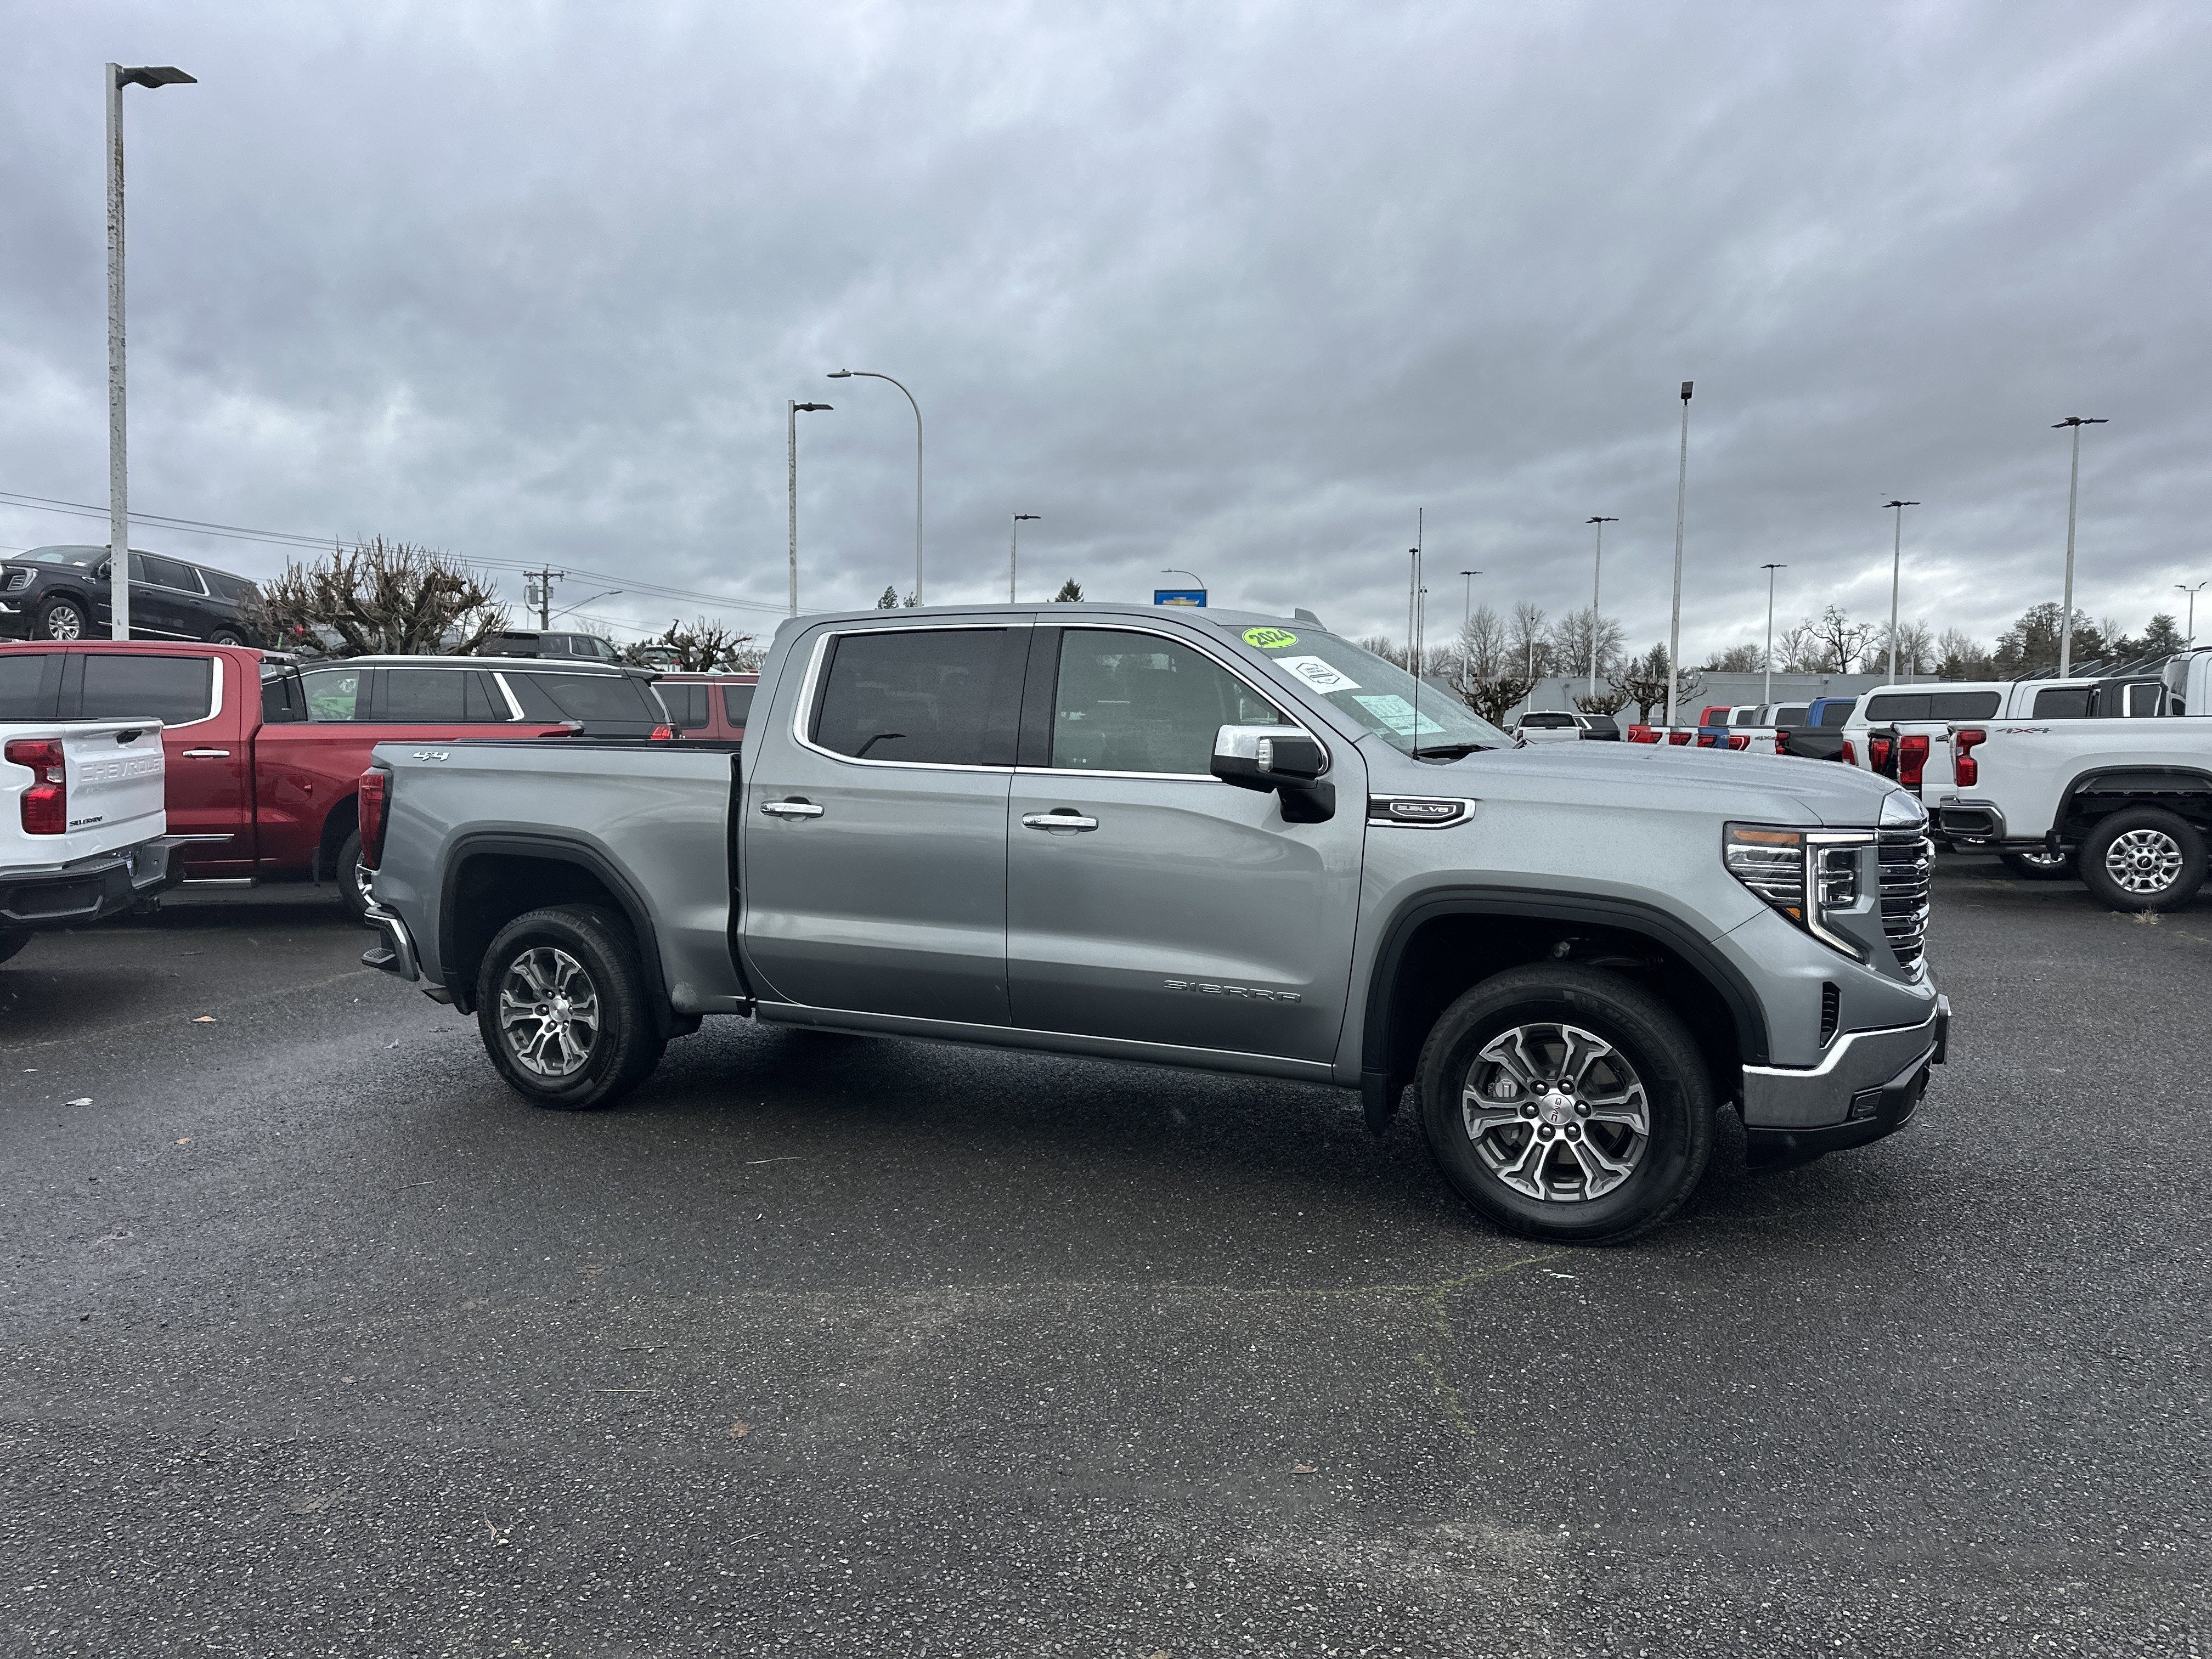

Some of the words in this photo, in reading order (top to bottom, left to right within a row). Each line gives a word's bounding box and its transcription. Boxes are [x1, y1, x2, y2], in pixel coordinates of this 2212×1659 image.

[1249, 630, 1294, 646] 2024
[1164, 980, 1301, 1003] SIERRA
[1550, 1097, 1562, 1122] GMC
